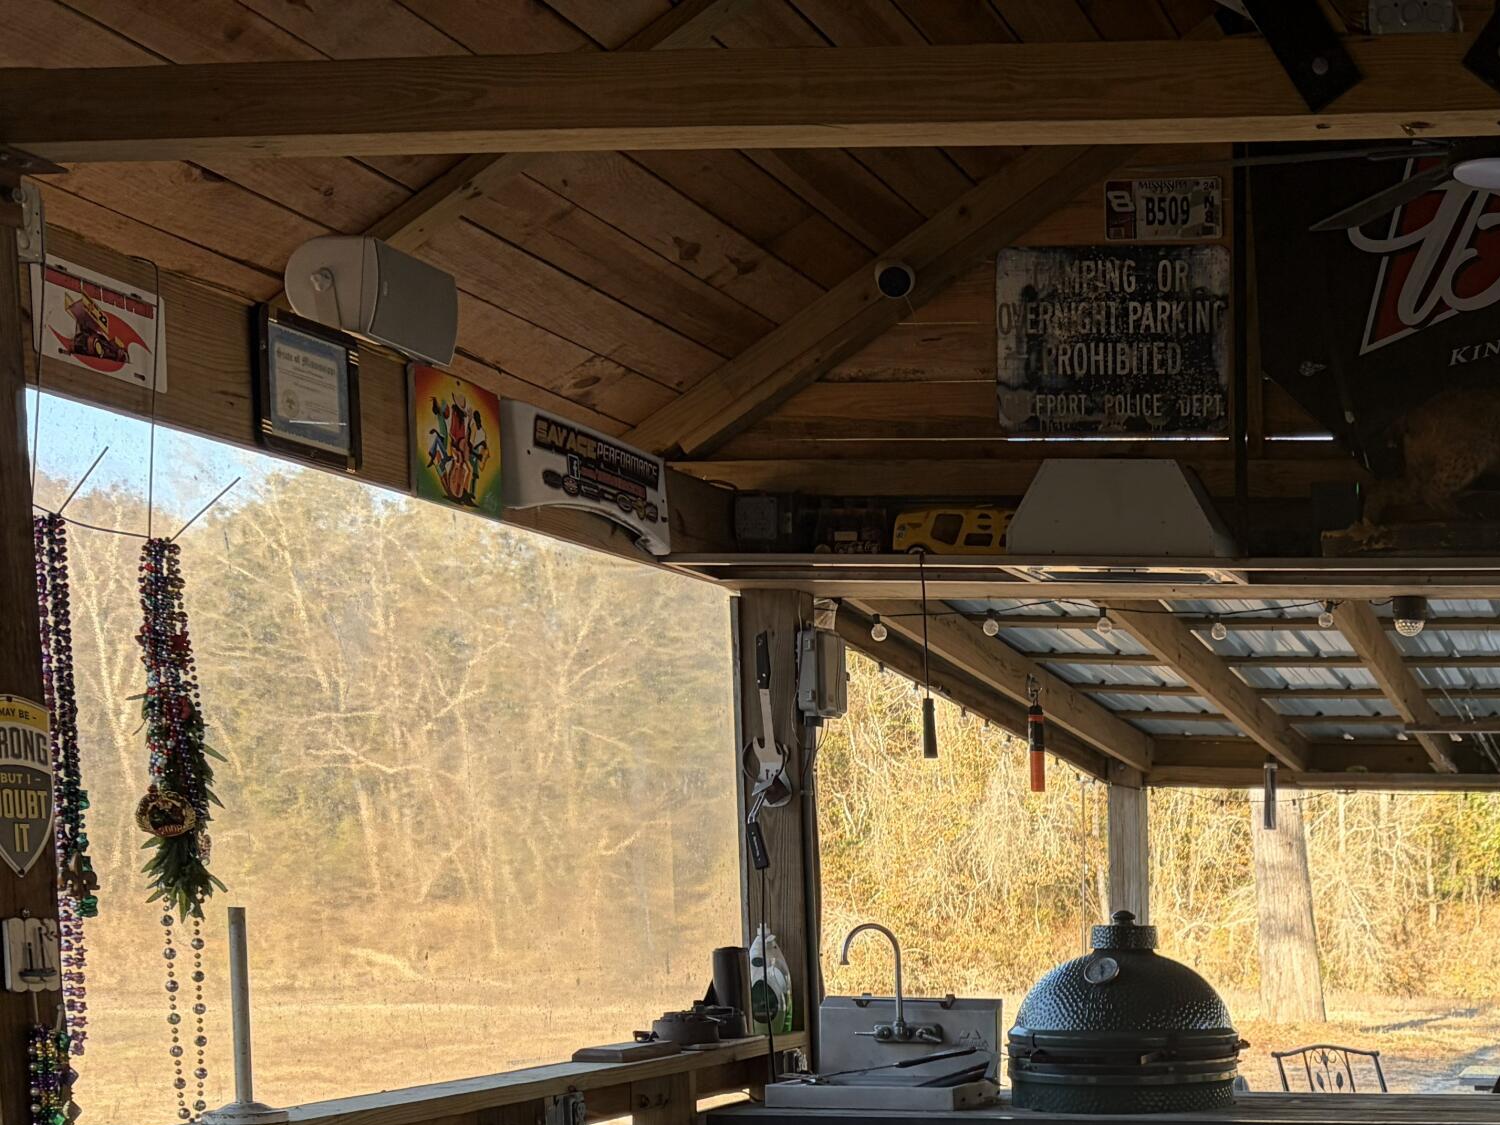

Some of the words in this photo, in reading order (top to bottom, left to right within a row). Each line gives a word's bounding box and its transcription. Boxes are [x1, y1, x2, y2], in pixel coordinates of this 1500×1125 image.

[1145, 196, 1190, 226] B509
[1033, 258, 1137, 294] CMPING
[1156, 259, 1190, 292] OR
[997, 300, 1116, 336] OVERNIGHT
[1041, 342, 1182, 376] PROHIBITED
[1104, 393, 1163, 417] POLICE
[597, 442, 658, 478] PERFORMANCE
[18, 709, 30, 720] BE
[0, 773, 23, 784] BUT
[0, 788, 48, 820] OUBT
[14, 823, 30, 852] IT
